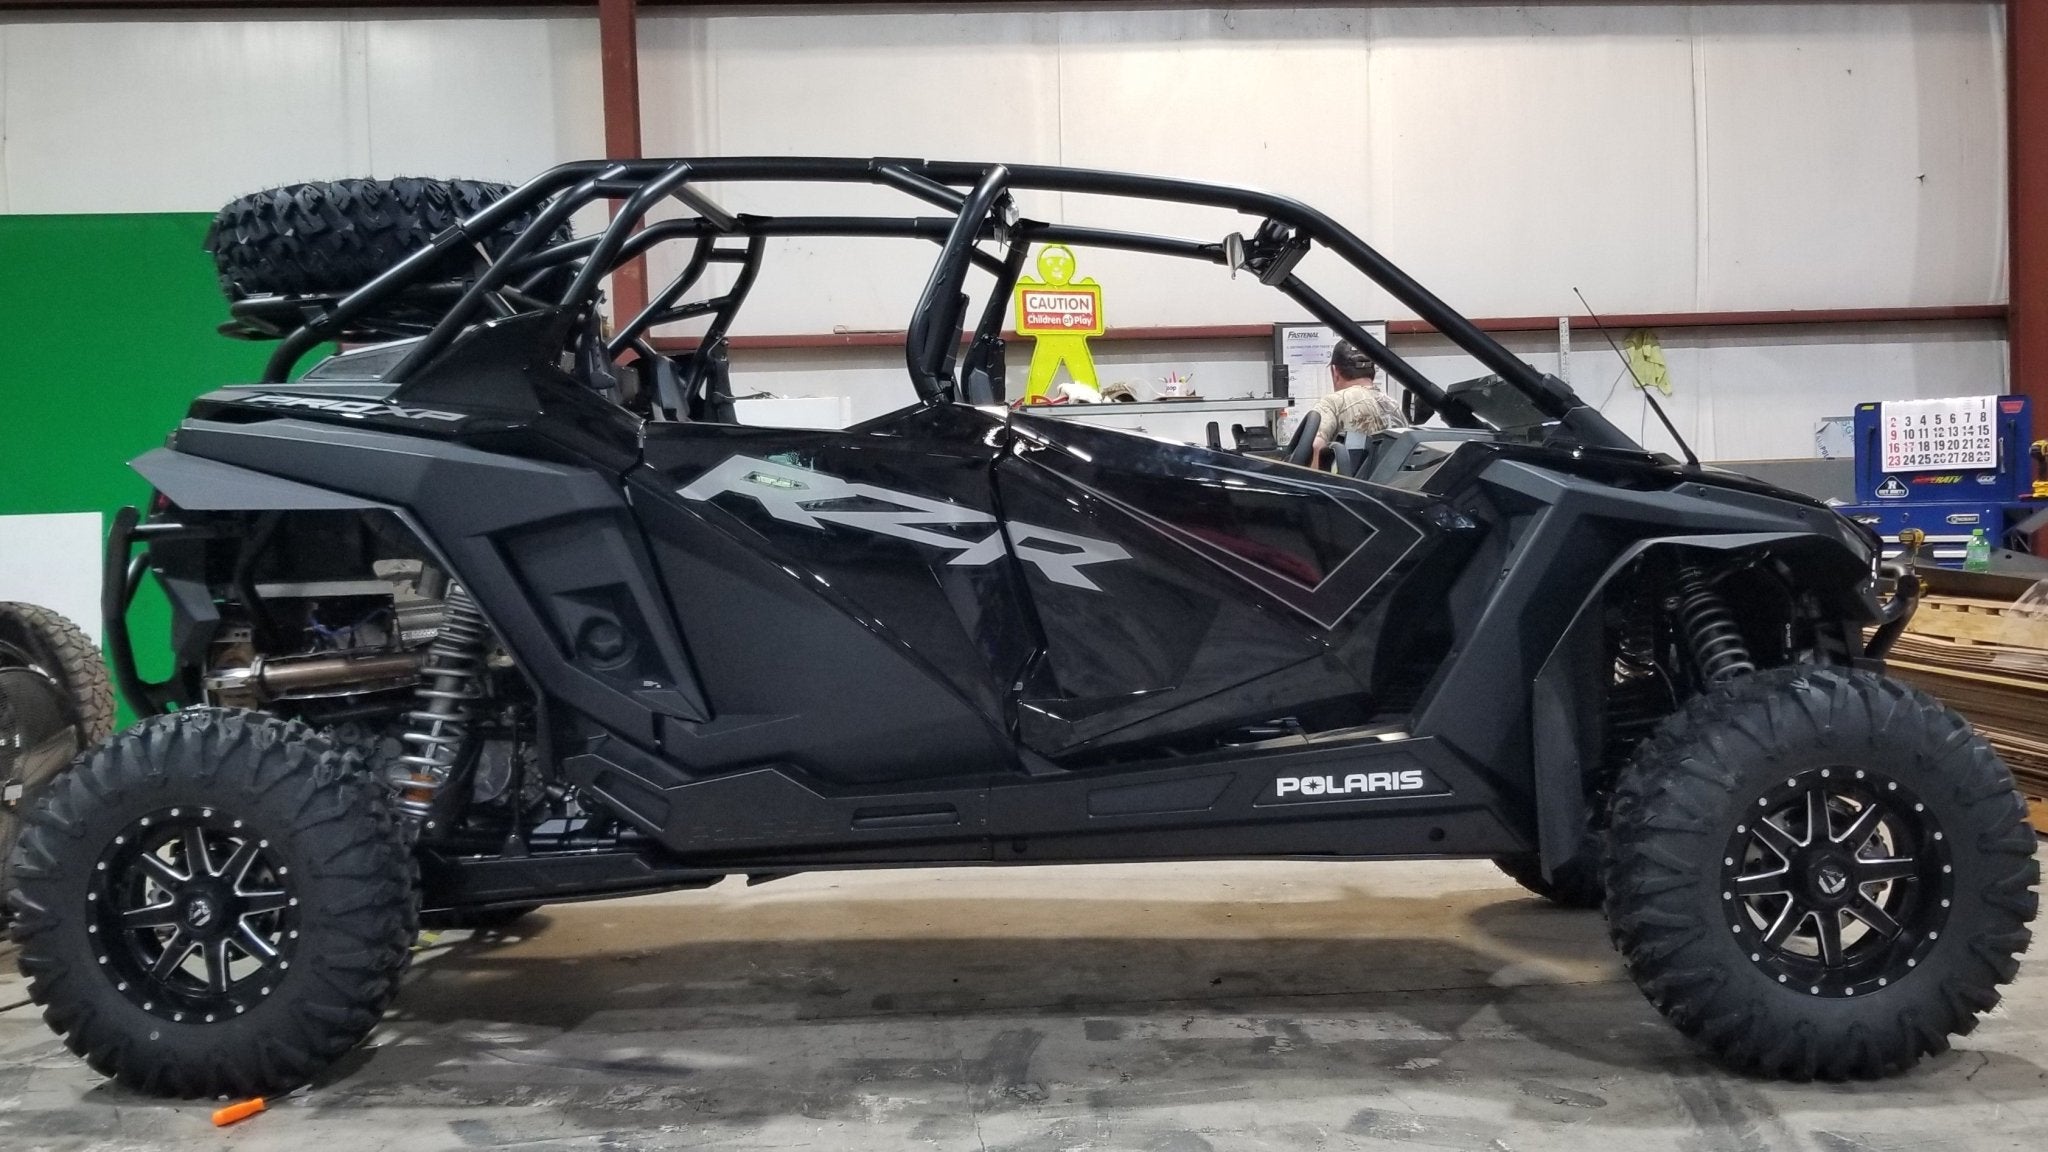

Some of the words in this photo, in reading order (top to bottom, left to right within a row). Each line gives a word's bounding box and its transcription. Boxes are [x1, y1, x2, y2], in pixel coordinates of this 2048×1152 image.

[1029, 296, 1090, 311] CAUTION
[1027, 314, 1061, 325] Children
[1074, 315, 1093, 326] Play
[243, 393, 384, 414] PRO
[364, 404, 469, 422] XP
[1980, 398, 1986, 410] 1
[1890, 416, 1897, 428] 2
[1904, 415, 1912, 427] 3
[1919, 414, 1927, 426] 4
[1934, 413, 1942, 426] 5
[1949, 412, 1957, 425] 6
[1964, 411, 1972, 424] 7
[1979, 411, 1987, 423] 8
[1890, 429, 1898, 441] 9
[1902, 428, 1915, 440] 10
[1917, 427, 1929, 439] 11
[1932, 426, 1945, 439] 12
[1947, 425, 1959, 438] 13
[1961, 424, 1975, 437] 14
[1977, 424, 1990, 436] 15
[1888, 442, 1901, 454] 16
[1902, 441, 1915, 453] 17
[1917, 440, 1931, 452] 18
[1932, 439, 1946, 452] 19
[1946, 438, 1960, 451] 20
[1961, 437, 1974, 450] 21
[1975, 437, 1991, 450] 22
[1887, 455, 1901, 467] 23
[1902, 453, 1917, 466] 24
[1917, 453, 1932, 466] 25
[1947, 451, 1960, 464] 27
[1960, 451, 1975, 463] 28
[675, 453, 1133, 592] RZR
[1276, 770, 1424, 797] POLARIS
